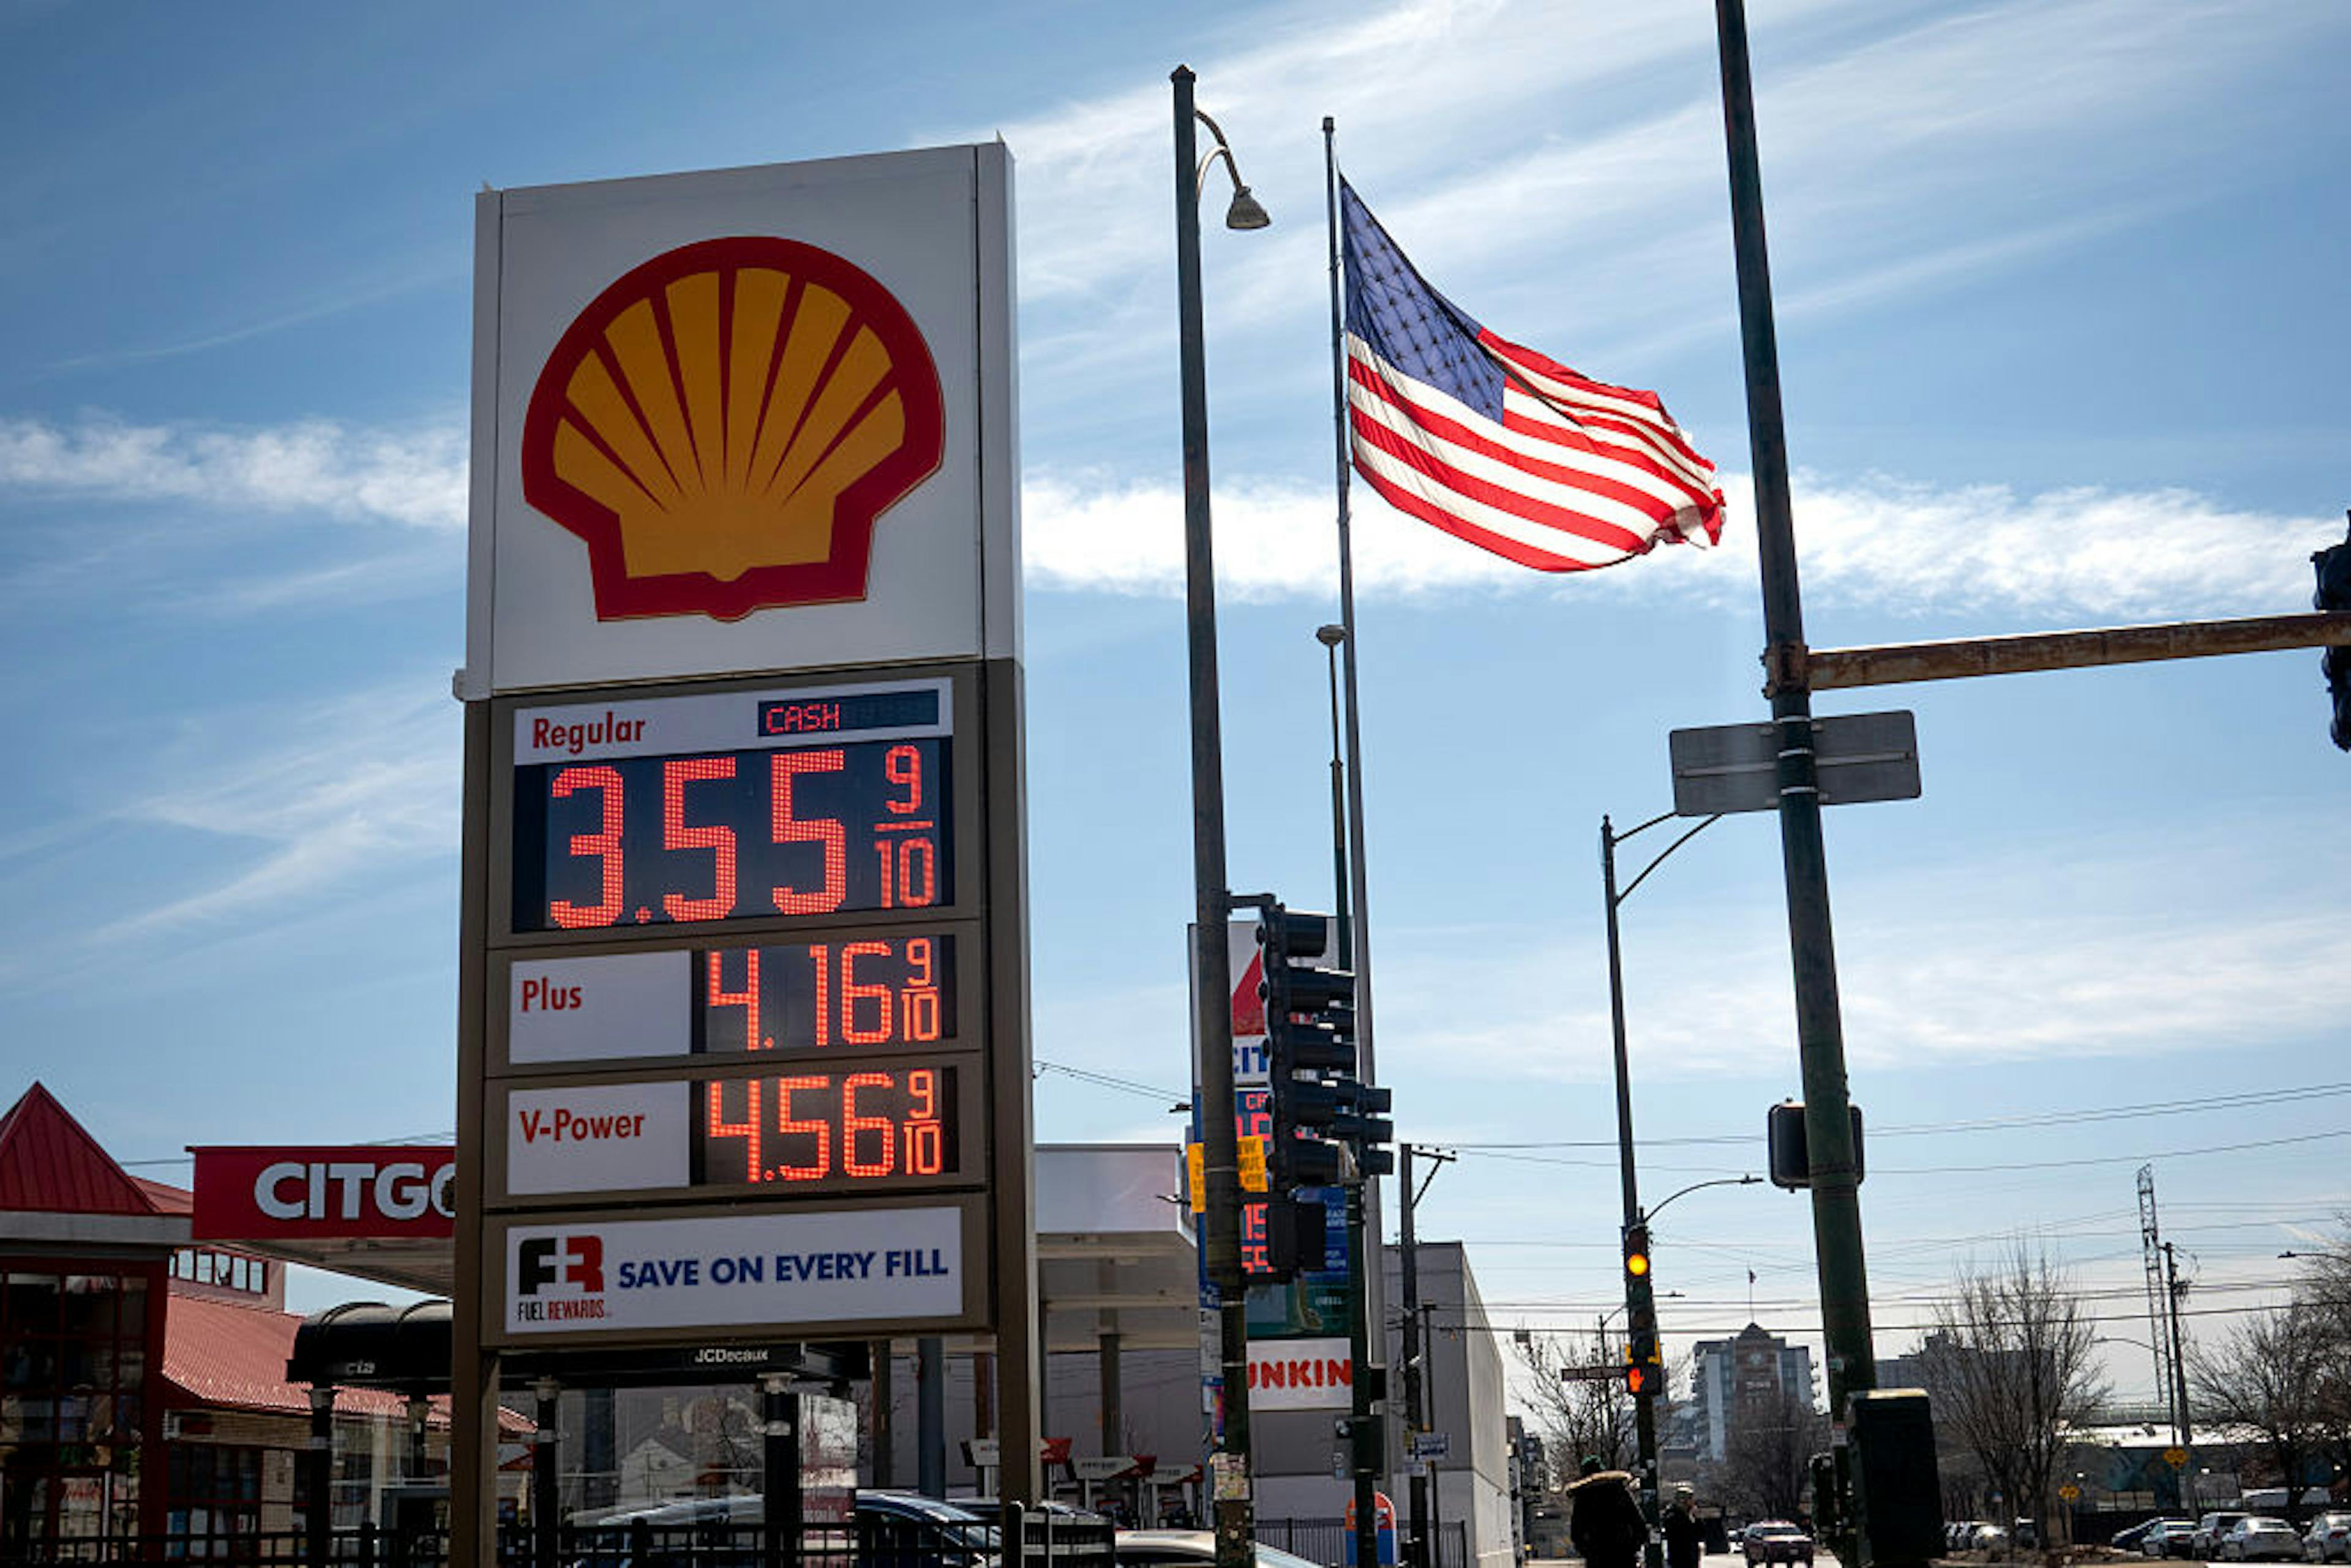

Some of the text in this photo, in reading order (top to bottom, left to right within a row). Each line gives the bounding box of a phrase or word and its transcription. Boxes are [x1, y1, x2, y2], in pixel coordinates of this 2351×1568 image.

[534, 713, 645, 753] Regular
[765, 703, 841, 733] CASH
[550, 749, 847, 929] 3.55
[522, 978, 582, 1011] Plus
[708, 940, 893, 1051] 4.16
[519, 1108, 645, 1143] V-Power
[708, 1071, 895, 1184] 4.56
[618, 1247, 948, 1289] SAVE ON EVERY FILL
[518, 1302, 545, 1320] FUEL
